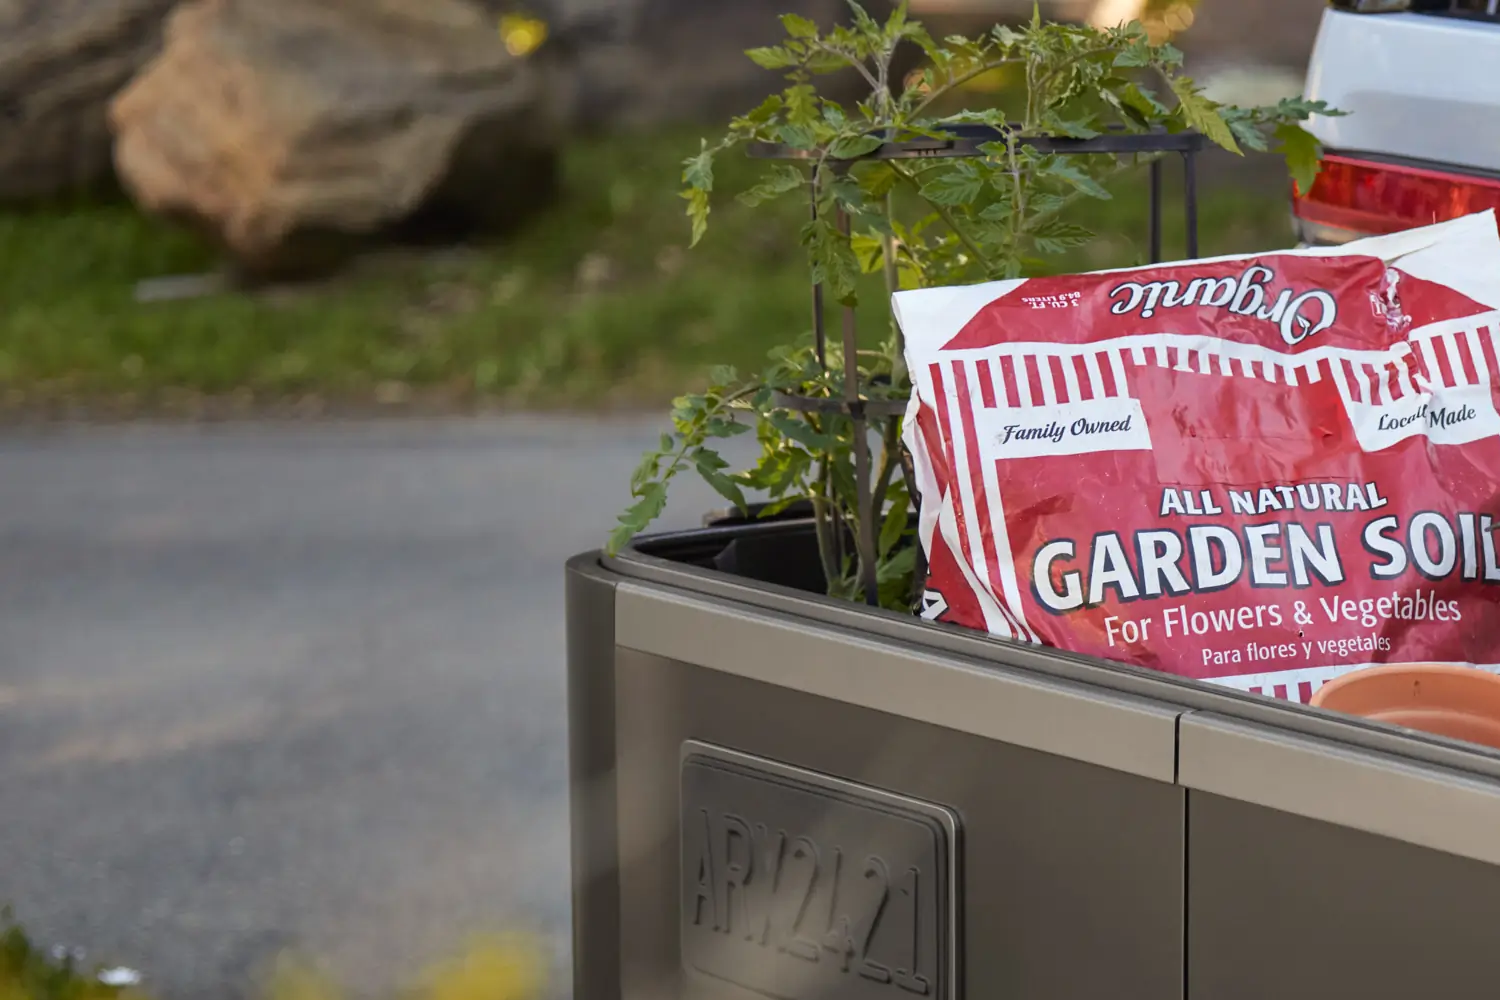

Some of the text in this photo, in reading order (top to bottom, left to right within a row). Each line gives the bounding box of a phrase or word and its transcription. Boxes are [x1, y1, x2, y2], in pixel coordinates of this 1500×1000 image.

[1028, 299, 1079, 309] 3 CU. FT.
[1058, 291, 1081, 300] 84.9
[1109, 265, 1338, 345] Organic
[1002, 414, 1132, 444] Family Owned
[1378, 404, 1476, 431] Locall Made
[1160, 482, 1388, 516] ALL NATURAL
[1032, 522, 1345, 614] GARDEN
[1104, 589, 1462, 647] For Flowers & Vegetables
[1202, 634, 1391, 666] Para flores y vegetales
